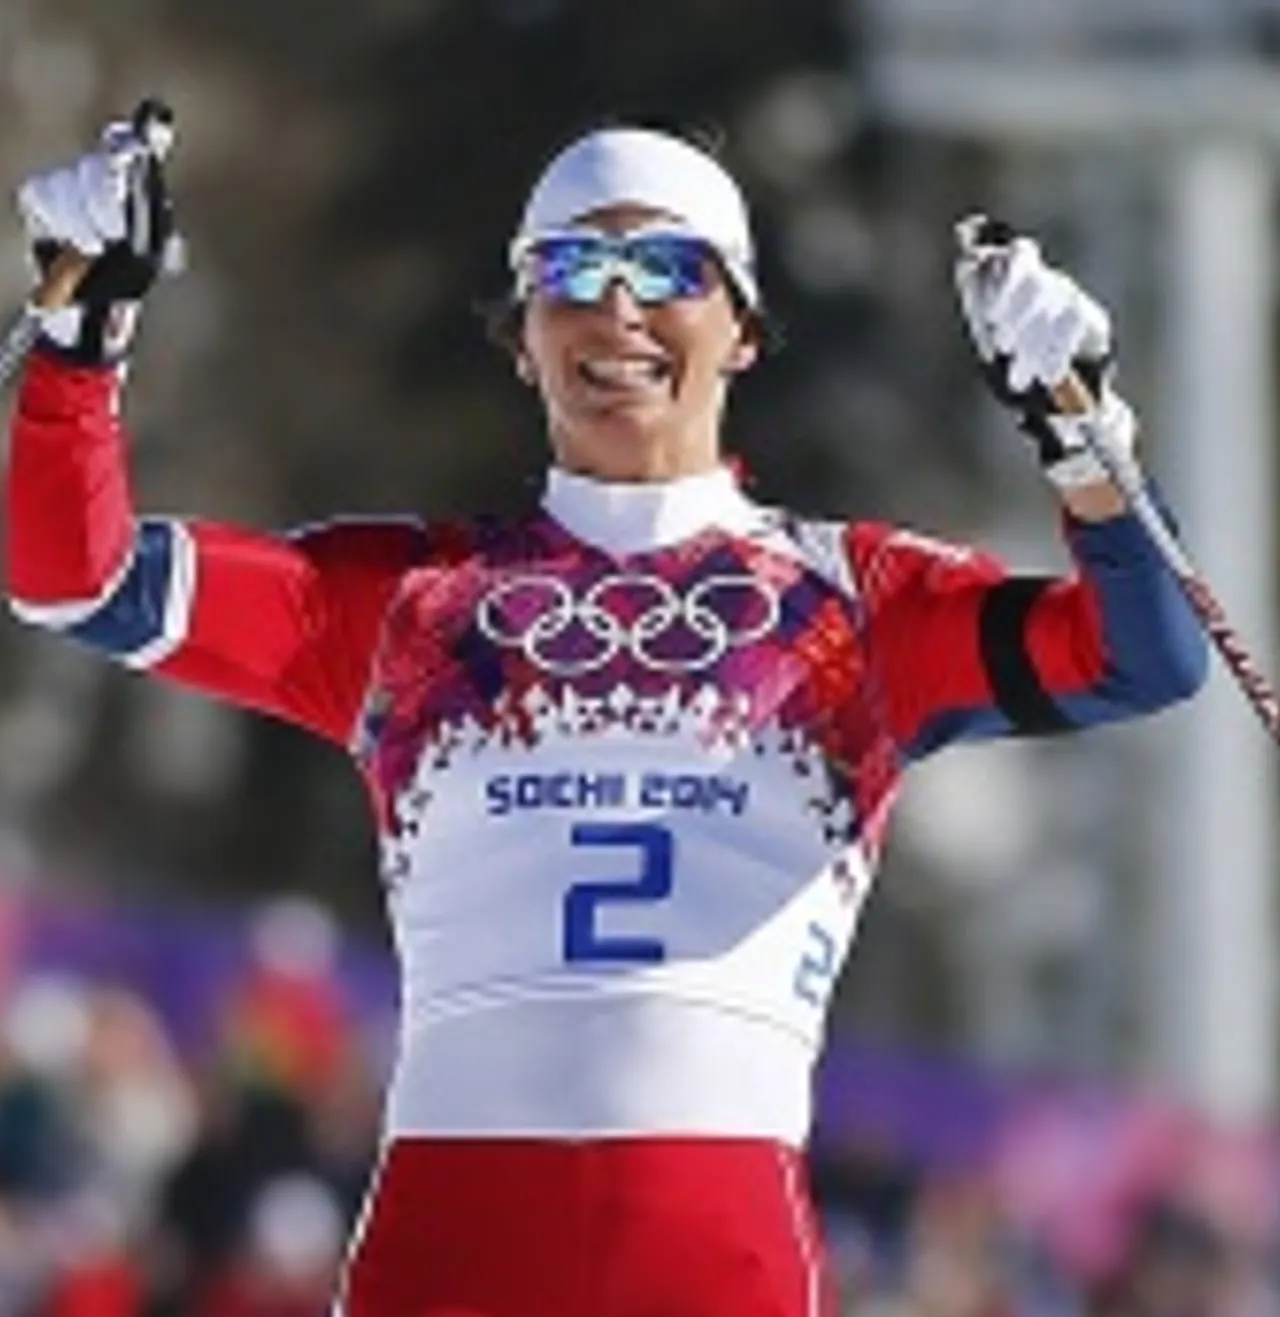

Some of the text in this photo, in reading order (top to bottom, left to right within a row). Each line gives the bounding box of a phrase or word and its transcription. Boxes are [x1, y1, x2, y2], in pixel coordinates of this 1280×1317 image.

[486, 775, 749, 816] SOCHI 2014
[563, 821, 673, 963] 2
